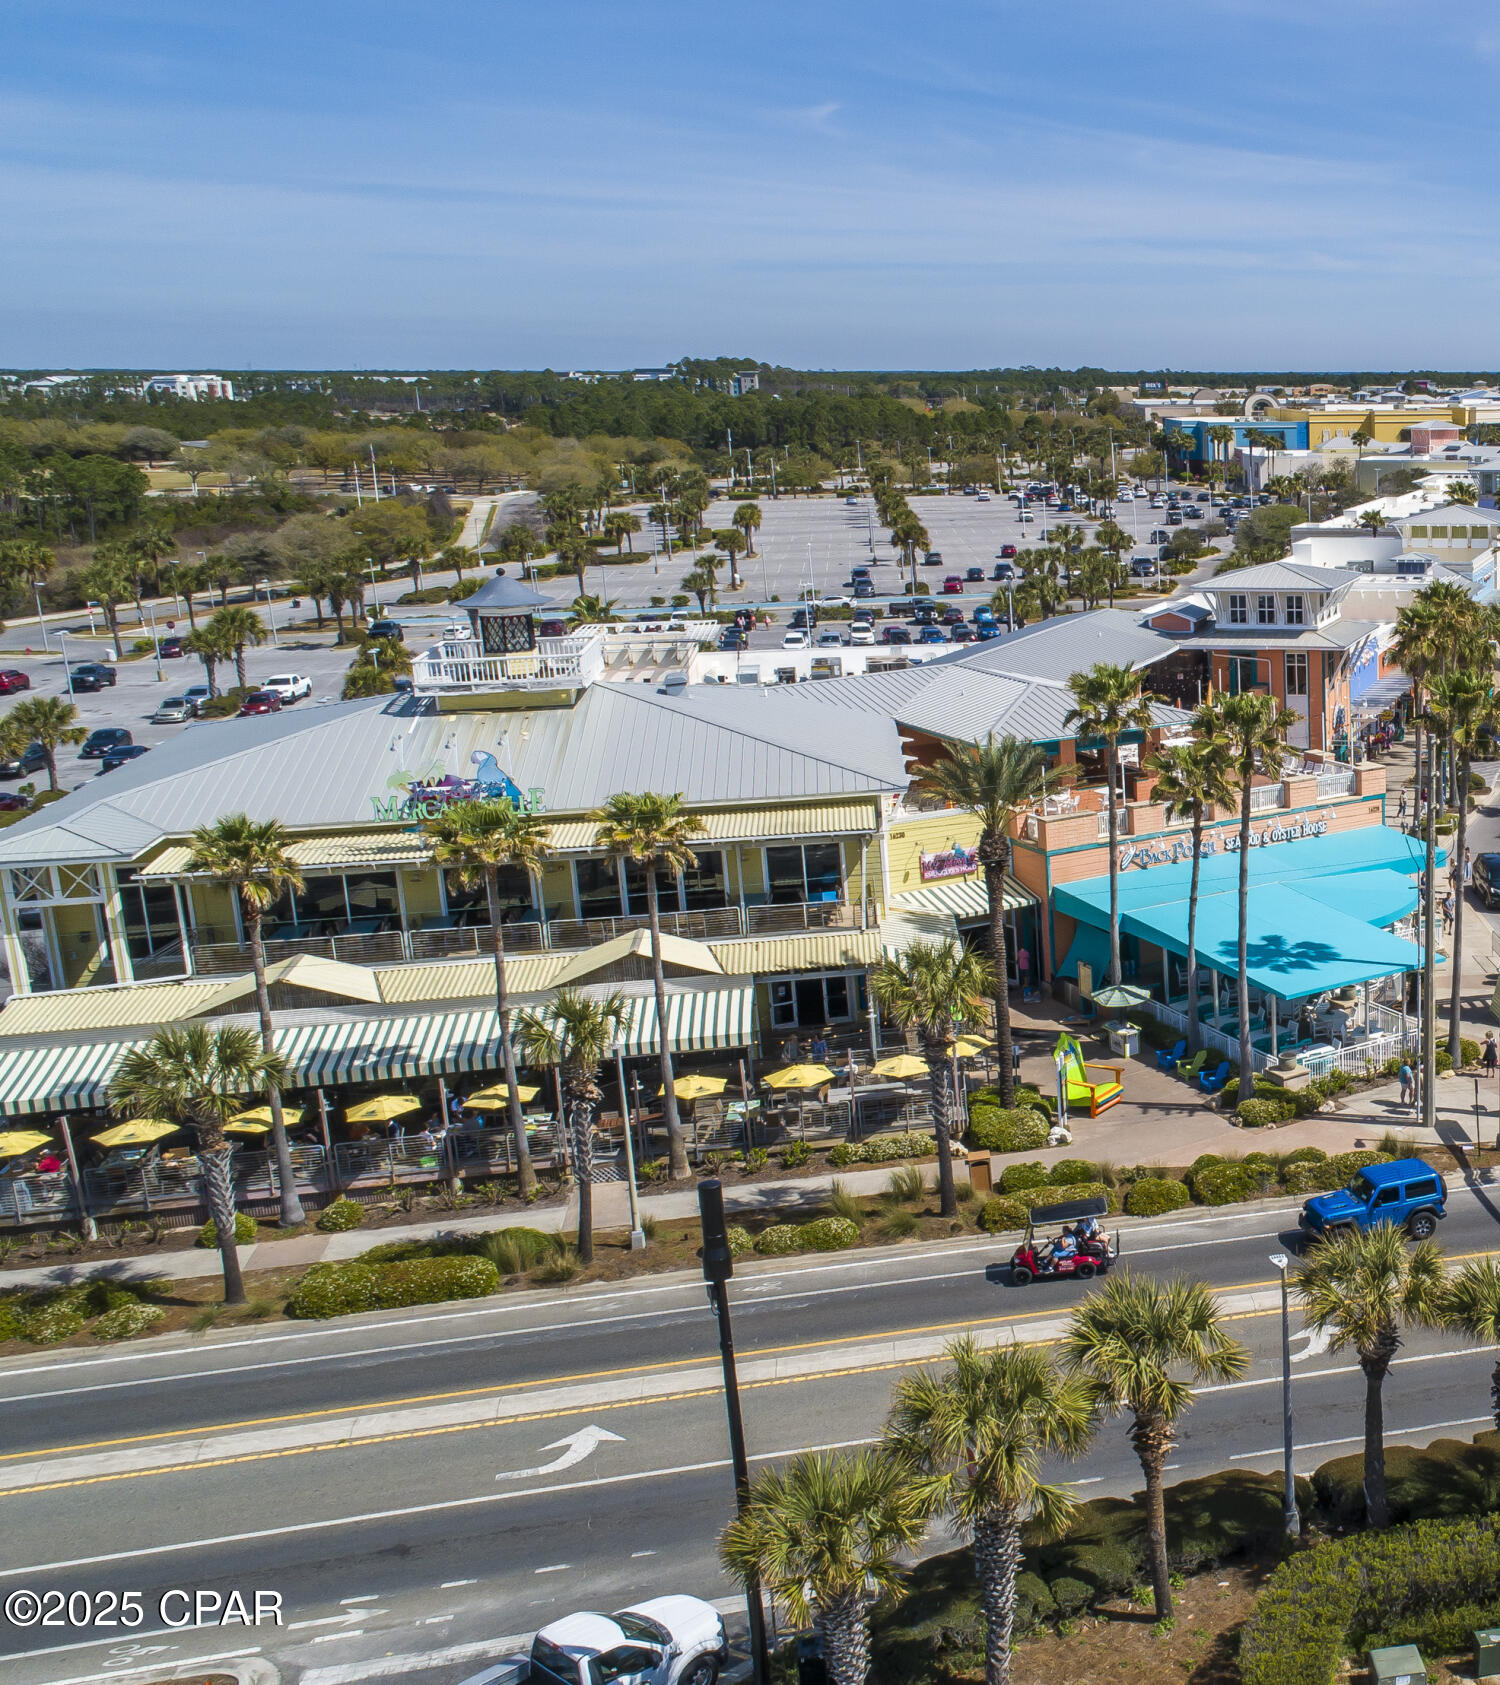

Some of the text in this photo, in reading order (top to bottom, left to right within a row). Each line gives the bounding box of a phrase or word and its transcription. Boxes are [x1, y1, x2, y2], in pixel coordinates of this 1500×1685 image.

[1225, 820, 1329, 850] SEAOD & OYSTER HOUSE
[1140, 841, 1217, 866] BACK POCH
